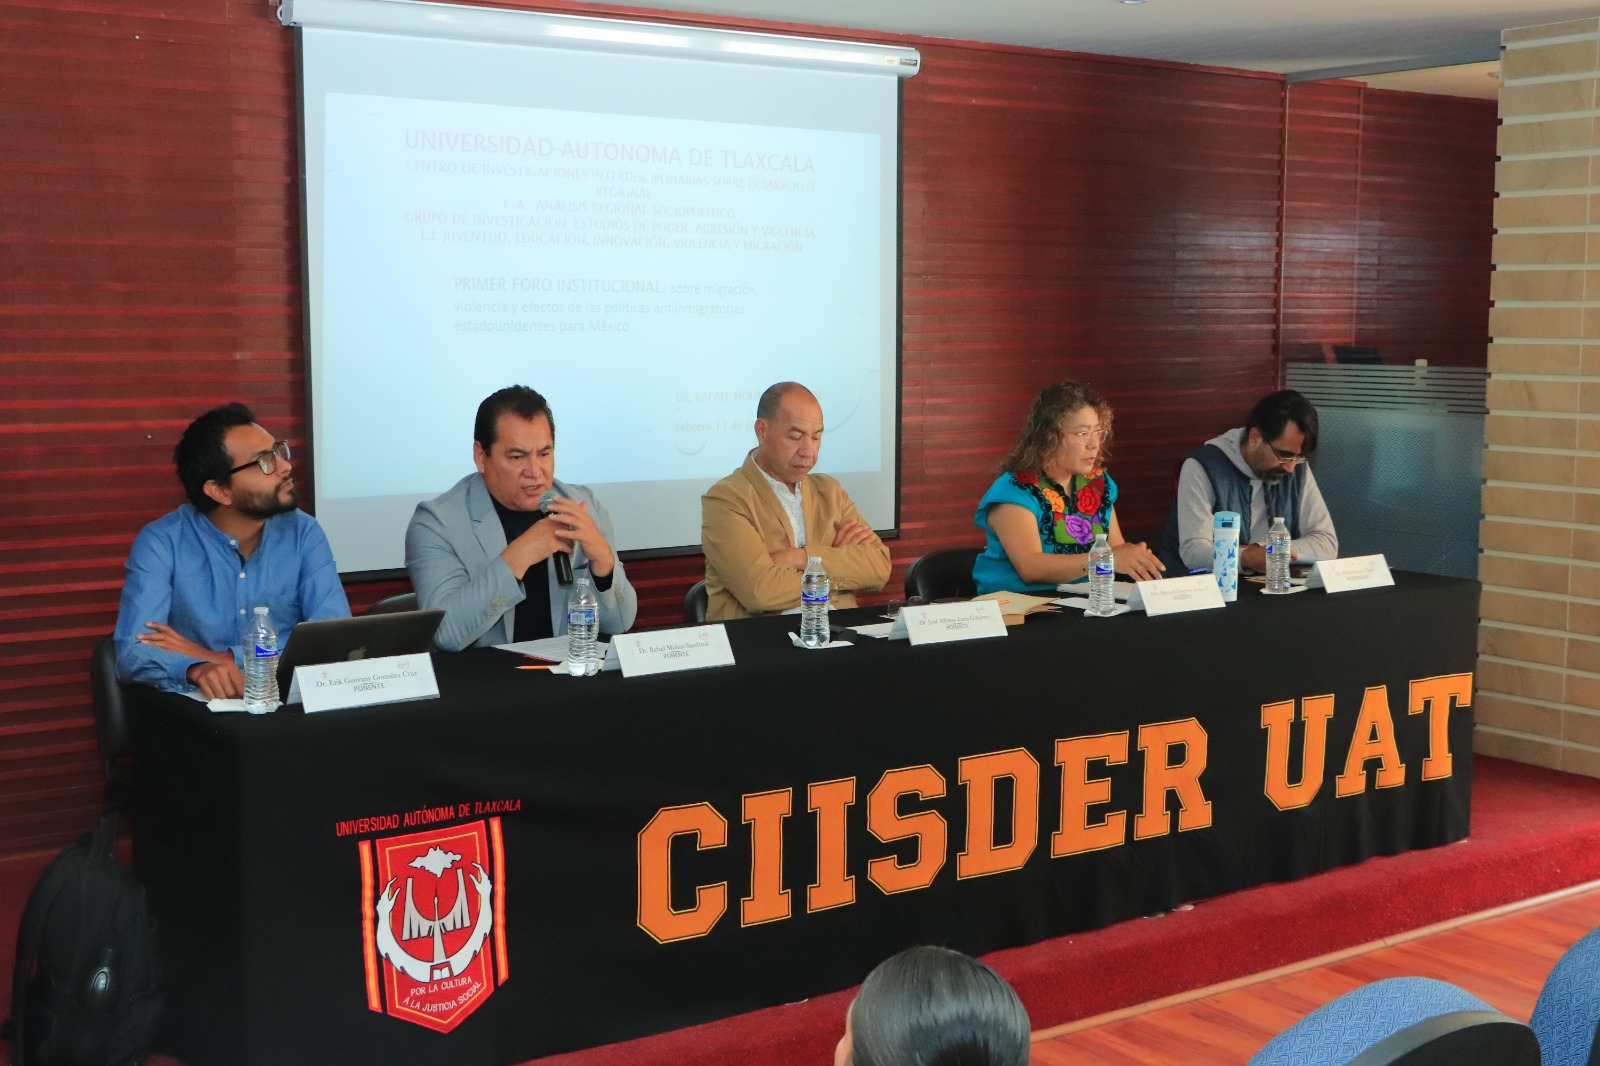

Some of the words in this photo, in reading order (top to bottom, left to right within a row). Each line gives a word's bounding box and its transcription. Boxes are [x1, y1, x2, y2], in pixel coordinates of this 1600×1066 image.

[405, 129, 554, 157] UNIVERSIDAD
[560, 138, 683, 166] AUTÓNOMA
[689, 148, 714, 167] DE
[719, 150, 816, 174] TLAXCALA
[405, 159, 458, 174] CENTRO
[462, 162, 478, 174] DE
[483, 164, 588, 180] INVESTIGACIONES
[592, 170, 709, 187] INTERDISCIPLINARIAS
[712, 176, 746, 188] SOBRE
[748, 178, 815, 193] DESARROLLO
[596, 186, 651, 199] REGIONAL
[503, 198, 528, 210] C.A.
[536, 197, 588, 213] ANÁLISIS
[591, 202, 647, 216] REGIONAL
[652, 204, 736, 219] SOCIOPOLÍTICO
[405, 211, 448, 224] GRUPO
[452, 213, 469, 225] DE
[574, 217, 630, 231] ESTUDIOS
[633, 220, 649, 232] DE
[652, 221, 692, 234] PODER,
[695, 221, 749, 236] AGRESIÓN
[751, 225, 758, 236] Y
[762, 225, 816, 239] VIOLENCIA
[443, 230, 511, 245] JUVENTUD,
[515, 230, 589, 247] EDUCACIÓN,
[593, 233, 670, 249] INNOVACIÓN,
[673, 238, 731, 250] VIOLENCIA
[734, 239, 741, 250] Y
[744, 239, 804, 253] MIGRACIÓN
[454, 276, 507, 292] PRIMER
[512, 277, 553, 292] FORO
[557, 278, 666, 294] INSTITUCIONAL:
[671, 283, 701, 294] sobre
[454, 300, 508, 313] violencia
[511, 303, 519, 315] y
[522, 300, 565, 313] efectos
[568, 301, 582, 313] de
[585, 301, 601, 313] las
[604, 301, 650, 315] políticas
[454, 320, 556, 333] estadounidenses
[559, 323, 585, 335] para
[589, 320, 630, 333] México
[695, 391, 731, 402] RAFAEL
[734, 390, 761, 402] MOLIN
[675, 421, 713, 432] Febrero
[716, 420, 728, 431] 13
[730, 420, 743, 431] de
[638, 647, 649, 655] Dr.
[649, 644, 666, 653] Rafael
[663, 651, 690, 660] PONENTE
[316, 680, 328, 688] Dr.
[329, 677, 343, 686] Erik
[344, 675, 372, 685] Geovany
[372, 671, 401, 682] González
[402, 669, 418, 679] Cruz
[353, 682, 386, 693] PONENTE
[636, 717, 1213, 944] CIISDER
[1260, 672, 1473, 811] UAT
[336, 814, 400, 837] UNIVERSIDAD
[403, 805, 456, 827] AUTÓNOMA
[458, 803, 471, 816] DE
[474, 799, 521, 815] TLAXCALA
[410, 986, 426, 996] POR
[429, 984, 439, 994] LA
[441, 976, 473, 991] CULTURA
[403, 997, 410, 1005] A
[410, 1000, 421, 1009] LA
[422, 1000, 458, 1012] JUSTICIA
[458, 980, 482, 1005] SOCIAL
